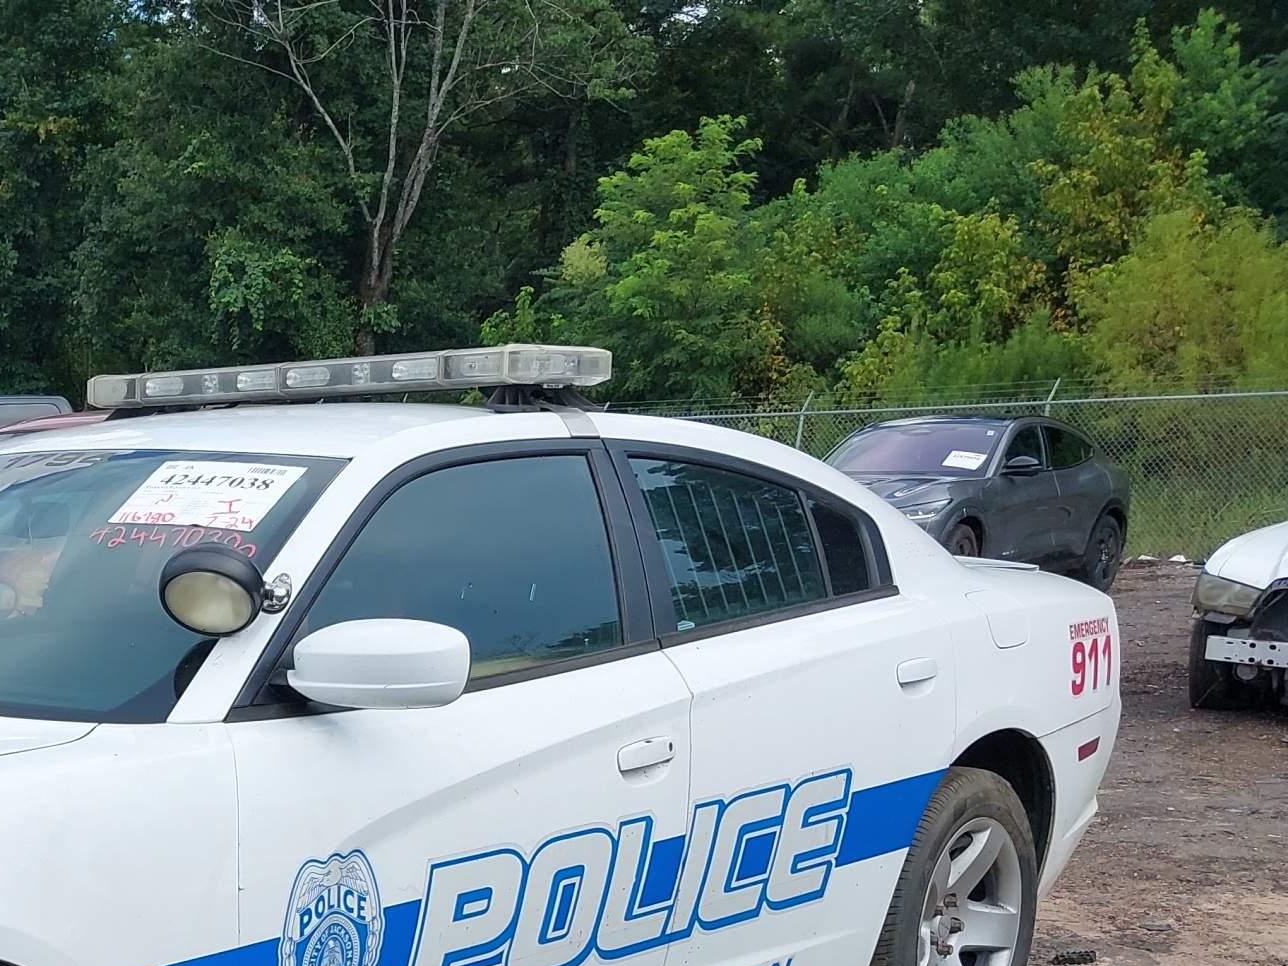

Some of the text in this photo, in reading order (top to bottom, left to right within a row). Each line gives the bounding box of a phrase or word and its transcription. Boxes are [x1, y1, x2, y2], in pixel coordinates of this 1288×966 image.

[159, 473, 275, 491] 42447038
[1069, 618, 1109, 640] EMERGENCY
[1071, 635, 1112, 696] 911
[299, 885, 368, 938] POLICE
